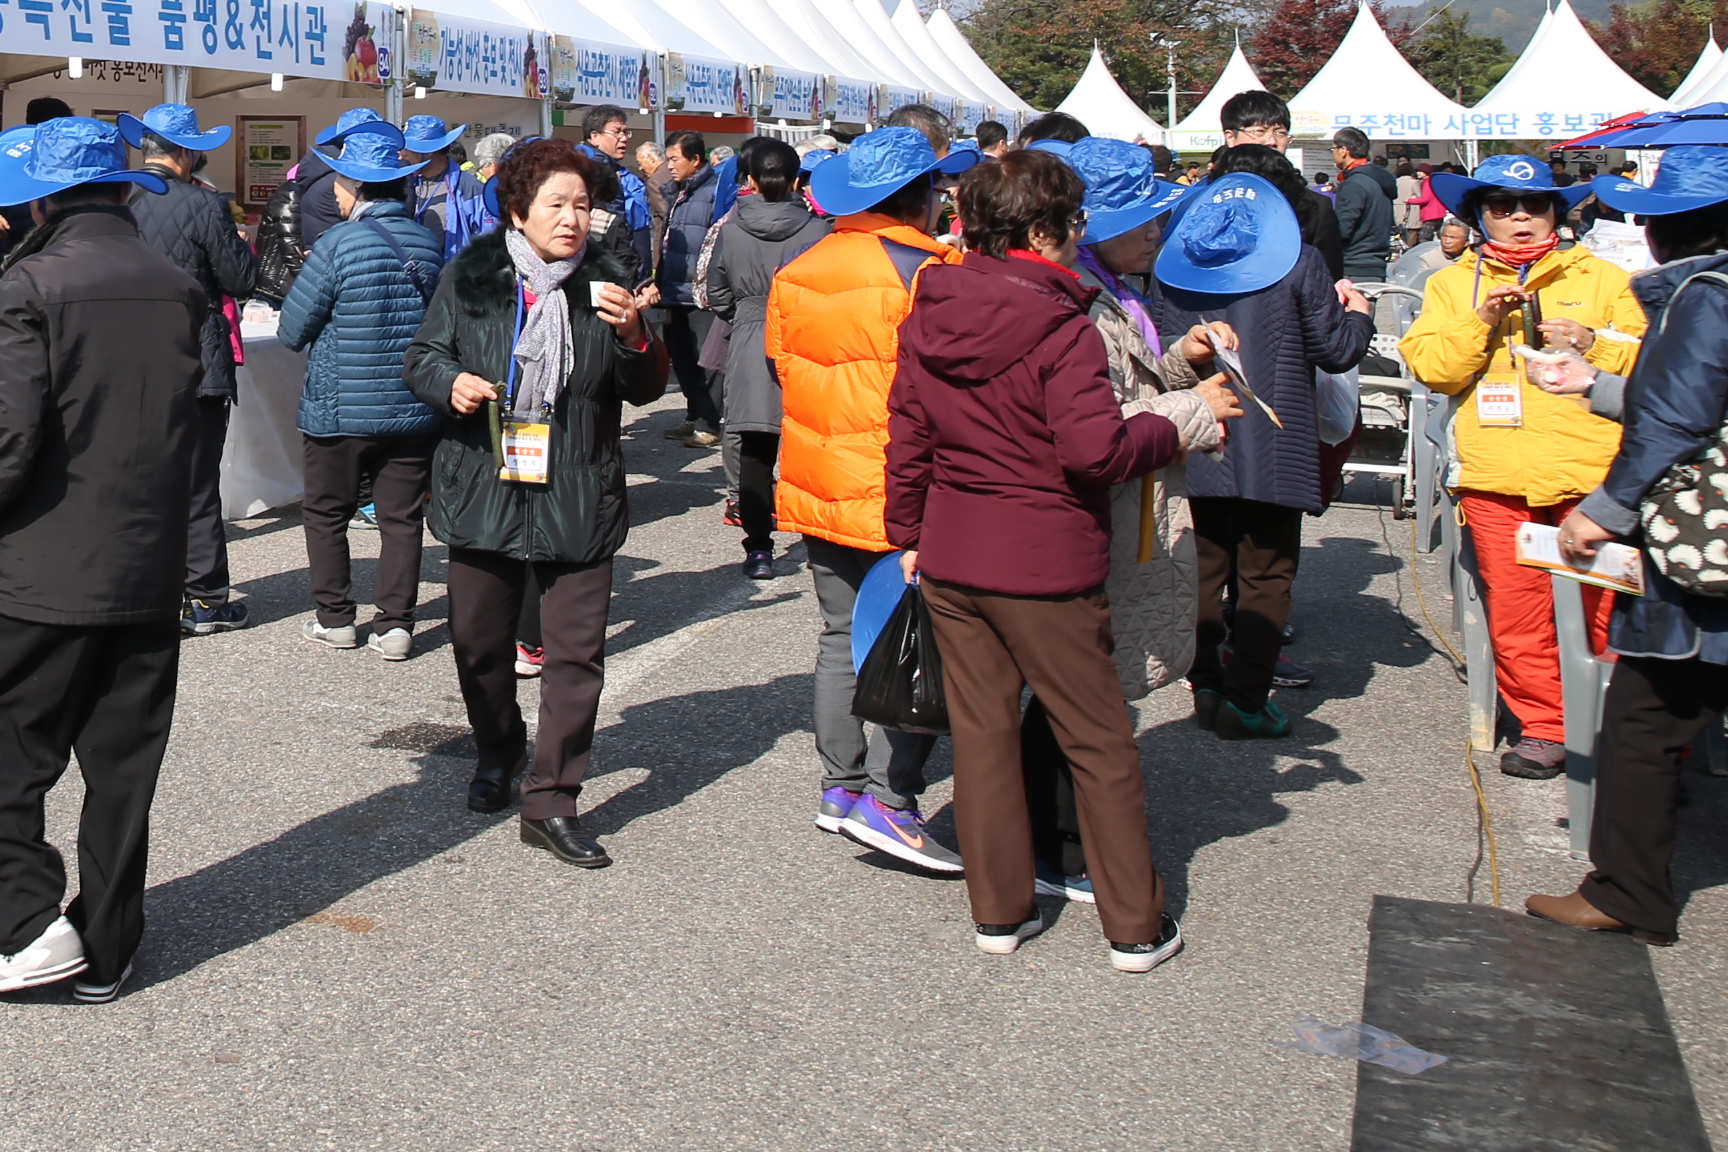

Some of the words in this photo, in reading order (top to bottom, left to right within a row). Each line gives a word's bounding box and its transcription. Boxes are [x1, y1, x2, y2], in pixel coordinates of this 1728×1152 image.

[377, 50, 390, 74] 94
[439, 26, 464, 81] 기능성
[465, 30, 480, 84] 버섯
[481, 30, 498, 85] 홍보
[1331, 113, 1433, 139] 무주천마
[1444, 113, 1522, 137] 사업단
